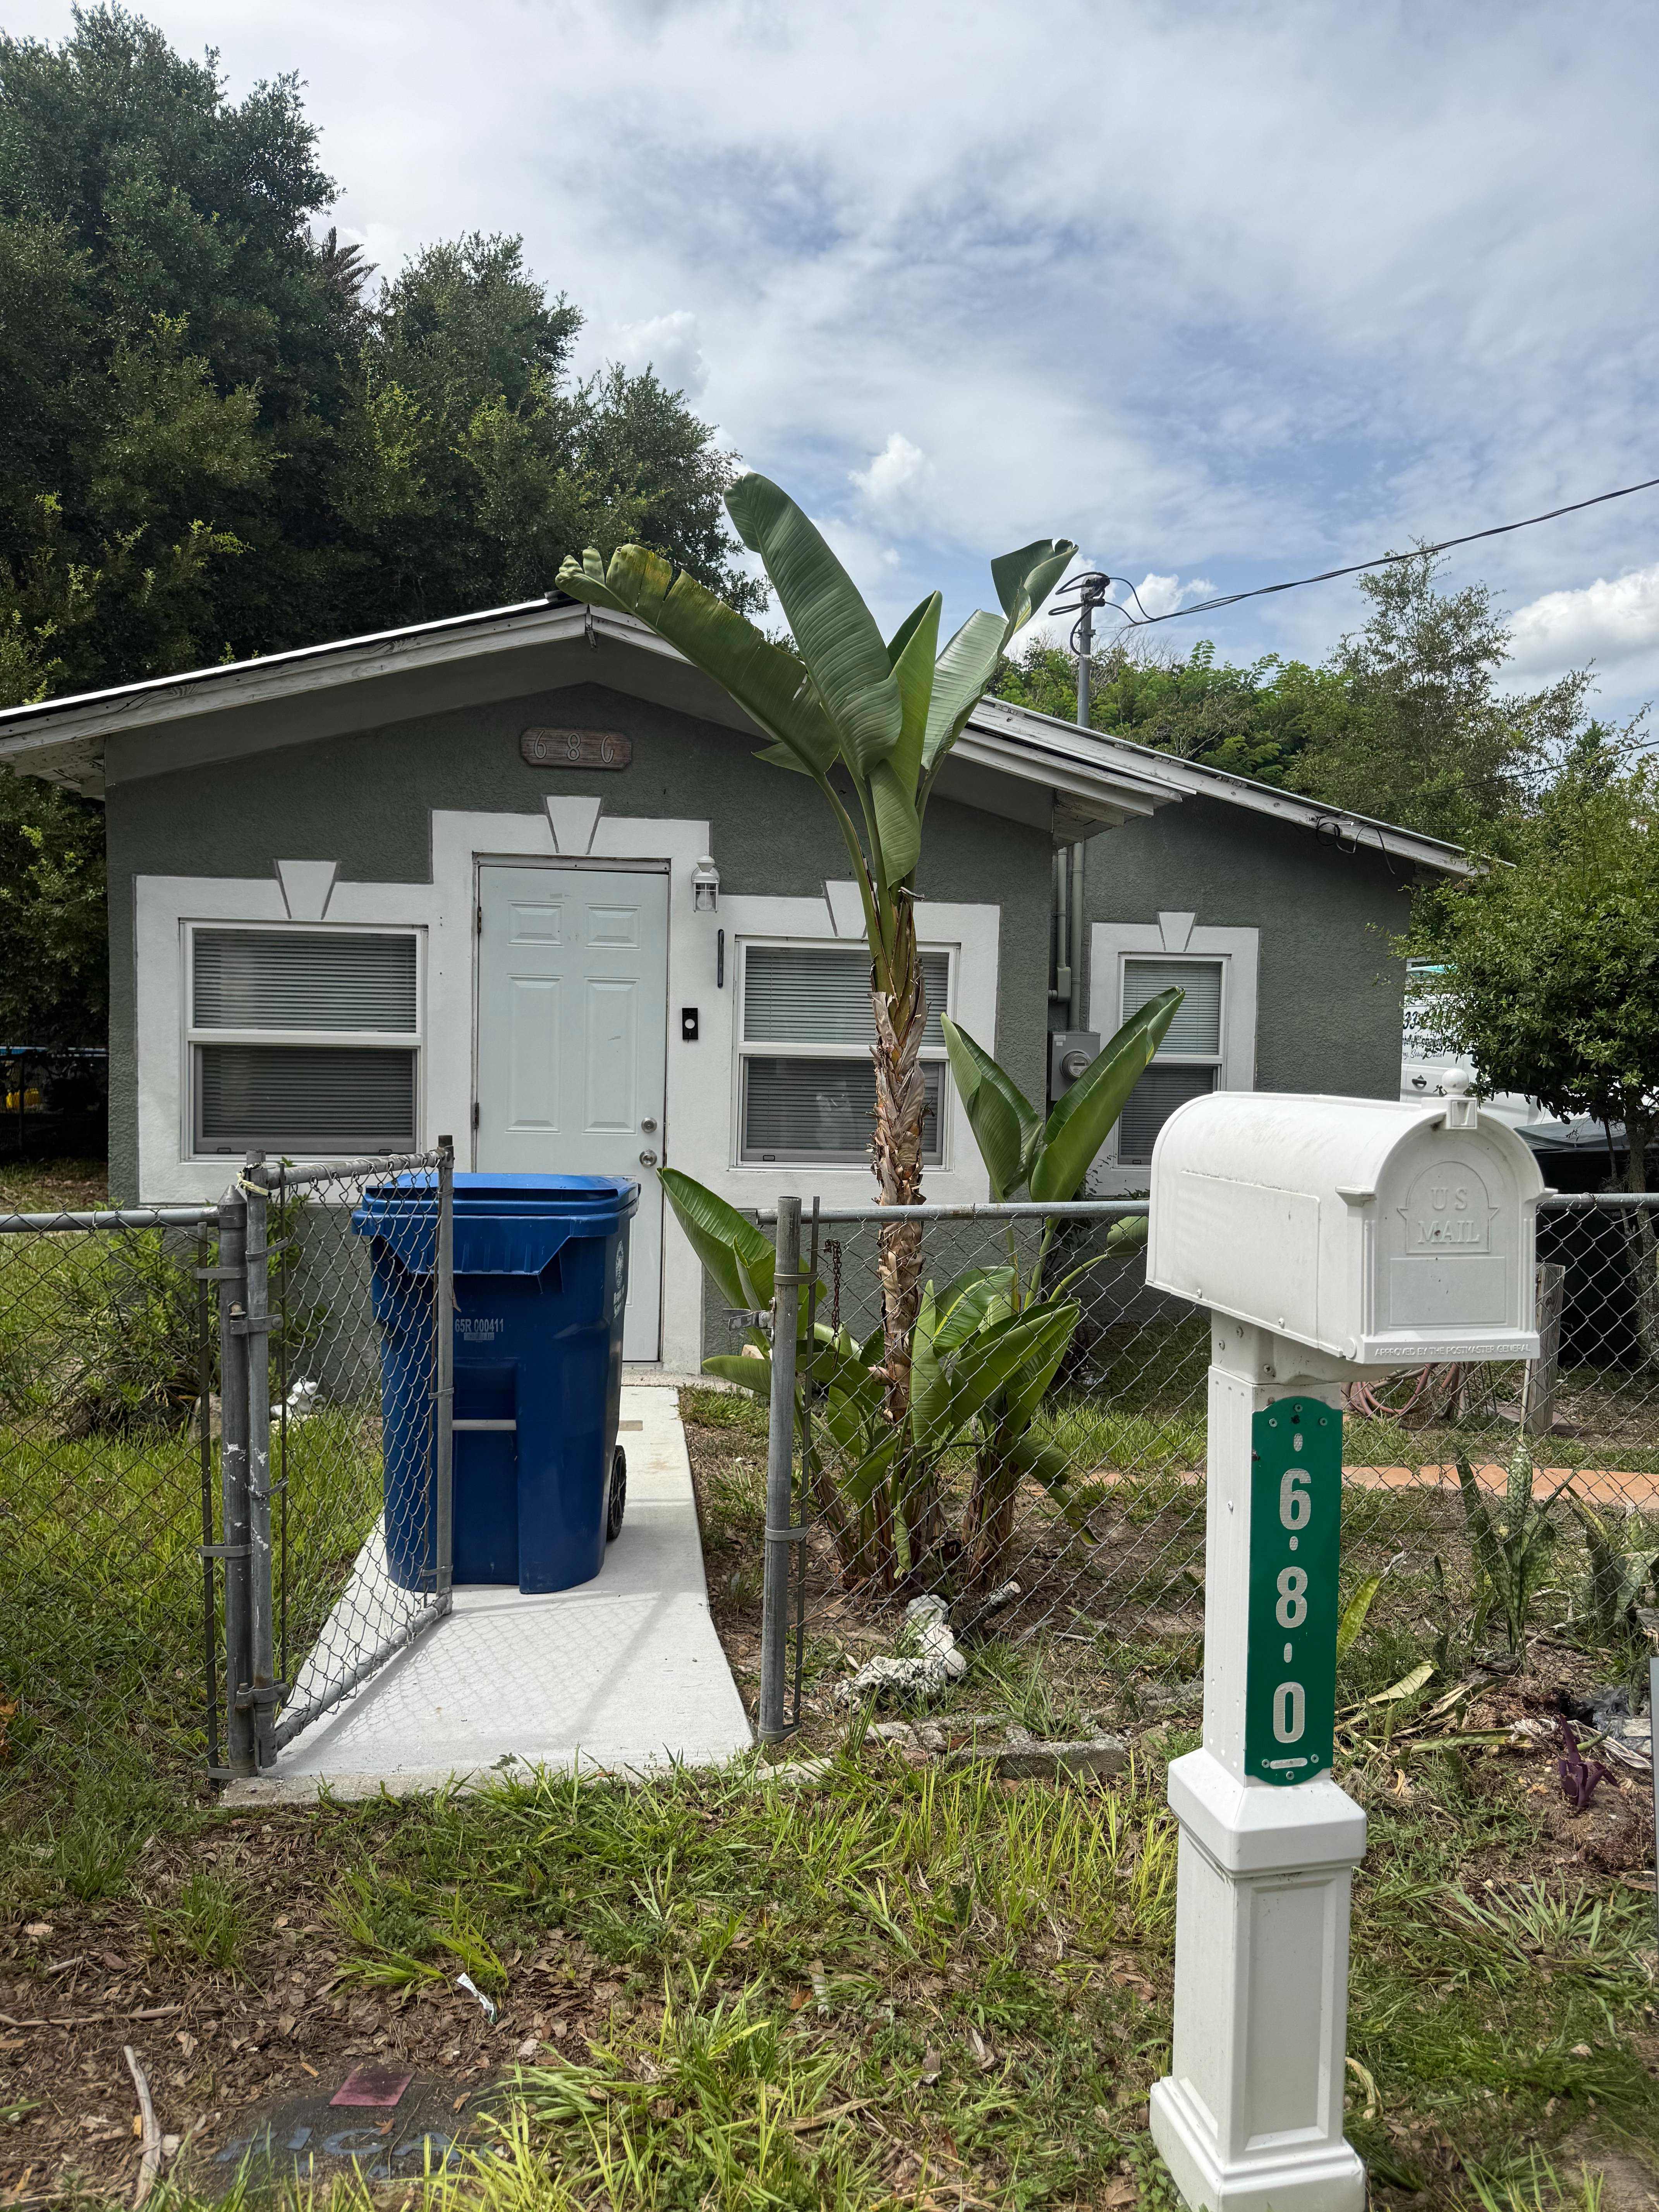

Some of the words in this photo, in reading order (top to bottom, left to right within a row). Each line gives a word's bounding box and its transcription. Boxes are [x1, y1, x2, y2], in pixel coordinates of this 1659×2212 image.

[1418, 1221, 1480, 1244] MAIL
[455, 1319, 472, 1332] 65R
[474, 1319, 503, 1332] 000411
[1375, 1348, 1415, 1356] APPROVED
[1417, 1347, 1427, 1355] BY
[1429, 1346, 1445, 1355] THE
[1446, 1345, 1495, 1355] POSTMASTER
[1497, 1344, 1531, 1353] GENERAL
